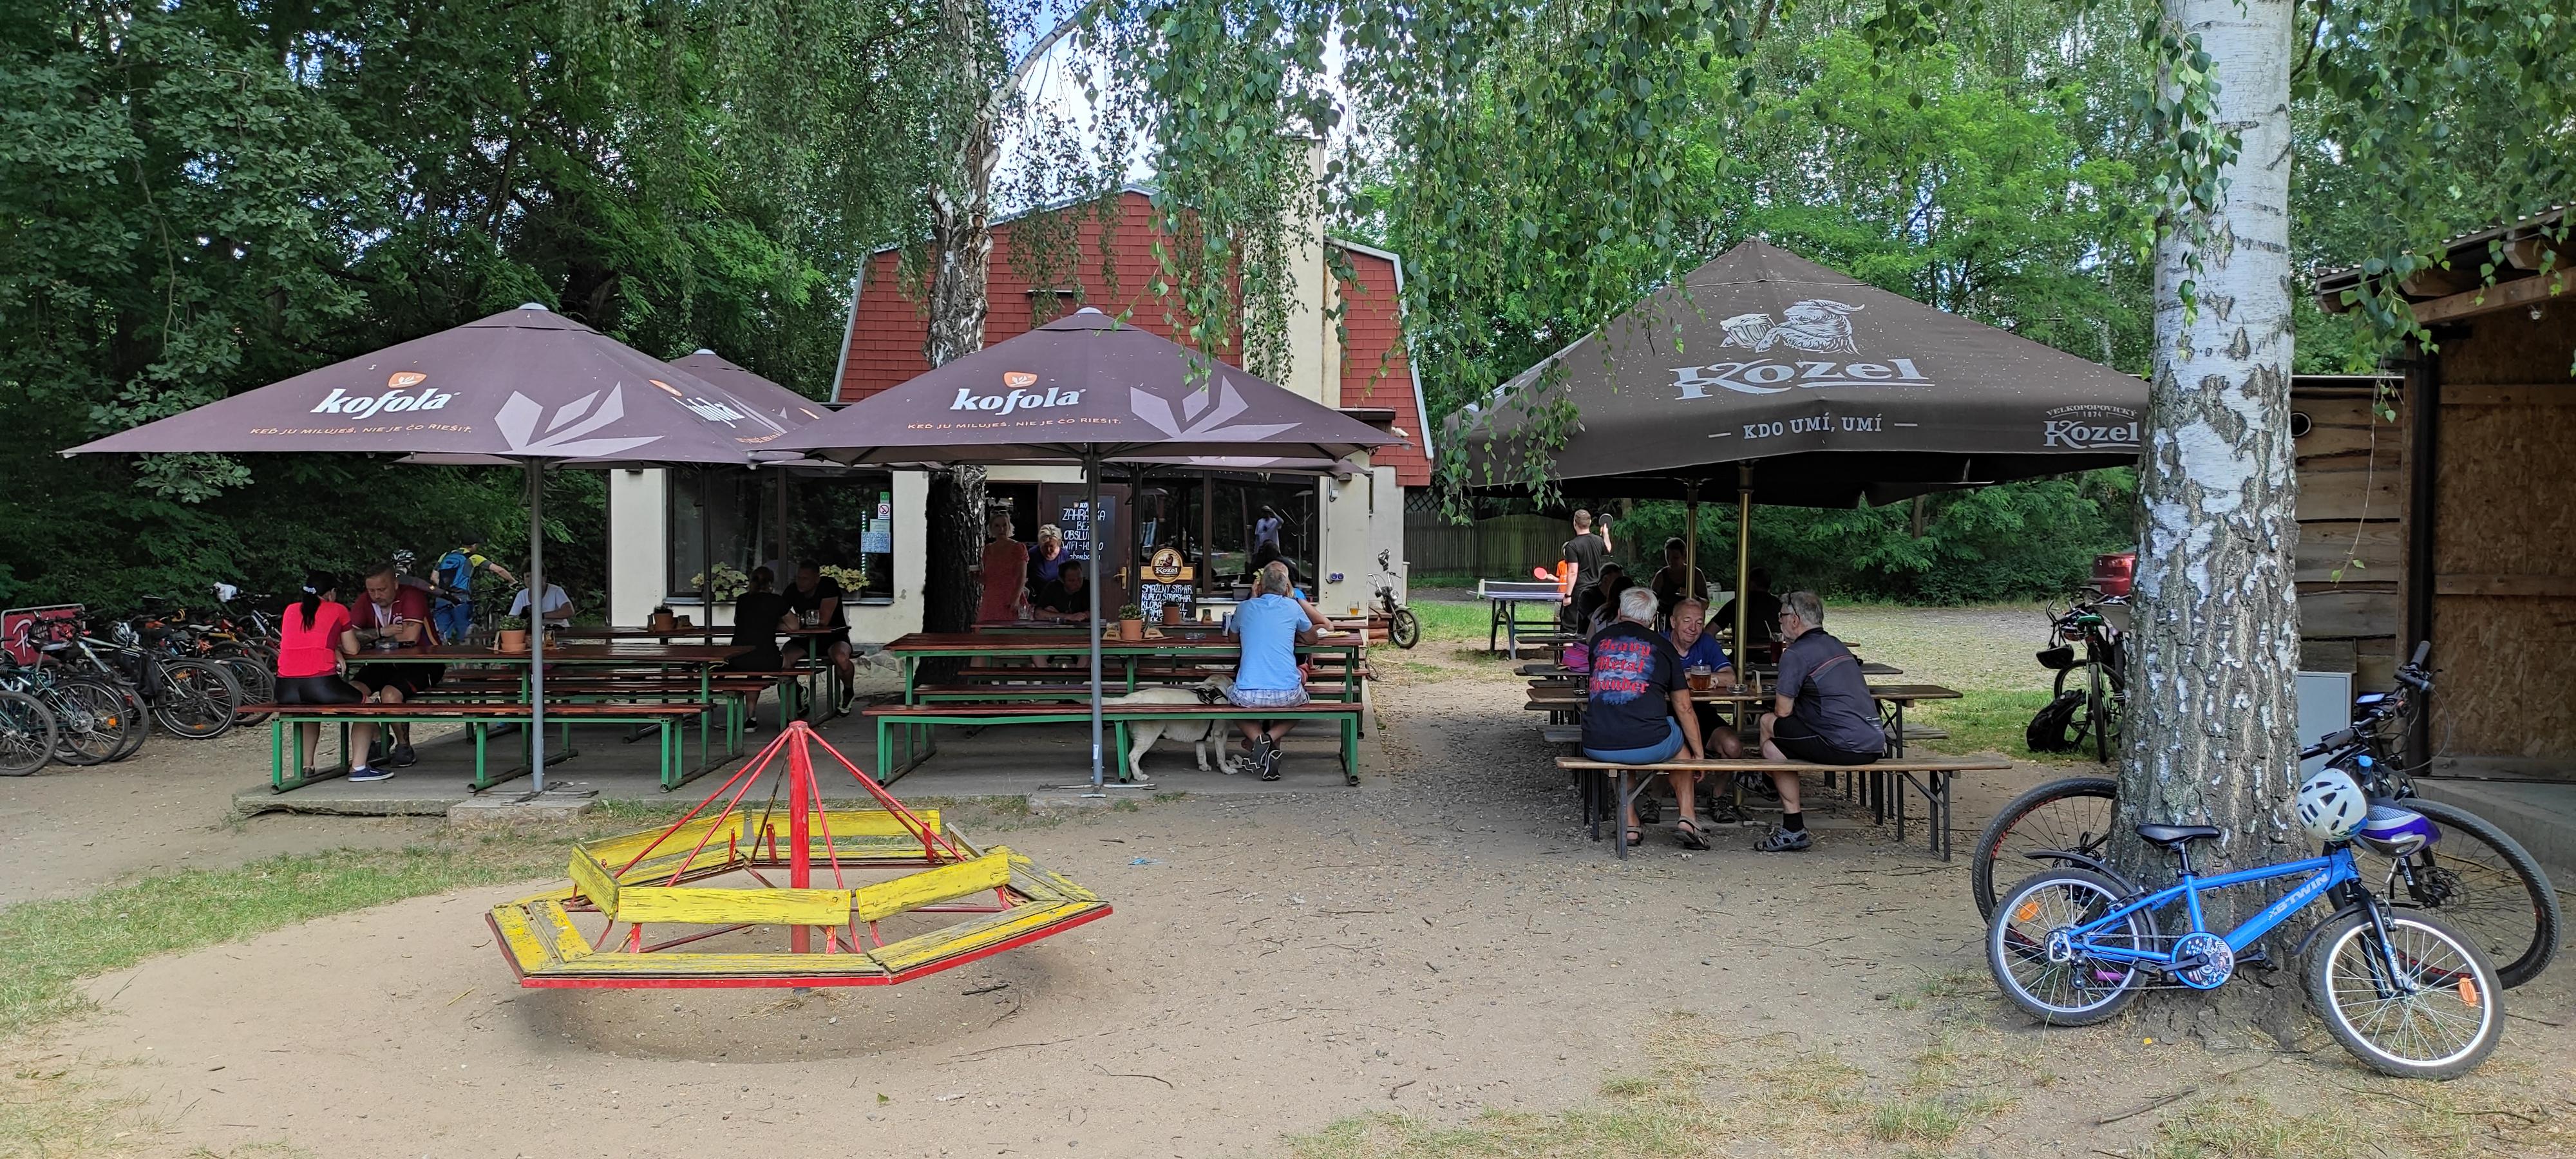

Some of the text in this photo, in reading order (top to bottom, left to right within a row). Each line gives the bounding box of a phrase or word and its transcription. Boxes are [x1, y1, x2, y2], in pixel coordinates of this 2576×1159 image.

[1669, 358, 1931, 400] Kozel
[310, 388, 453, 420] kofola
[949, 388, 1081, 416] kofola
[2046, 404, 2138, 417] VELKOPOPOVICKÝ
[1743, 412, 1882, 440] KDO UMÍ, UMÍ
[2043, 420, 2141, 449] Kozel
[1155, 567, 1179, 575] Kozel
[1599, 639, 1651, 657] Heavy
[1594, 655, 1644, 674] Metal
